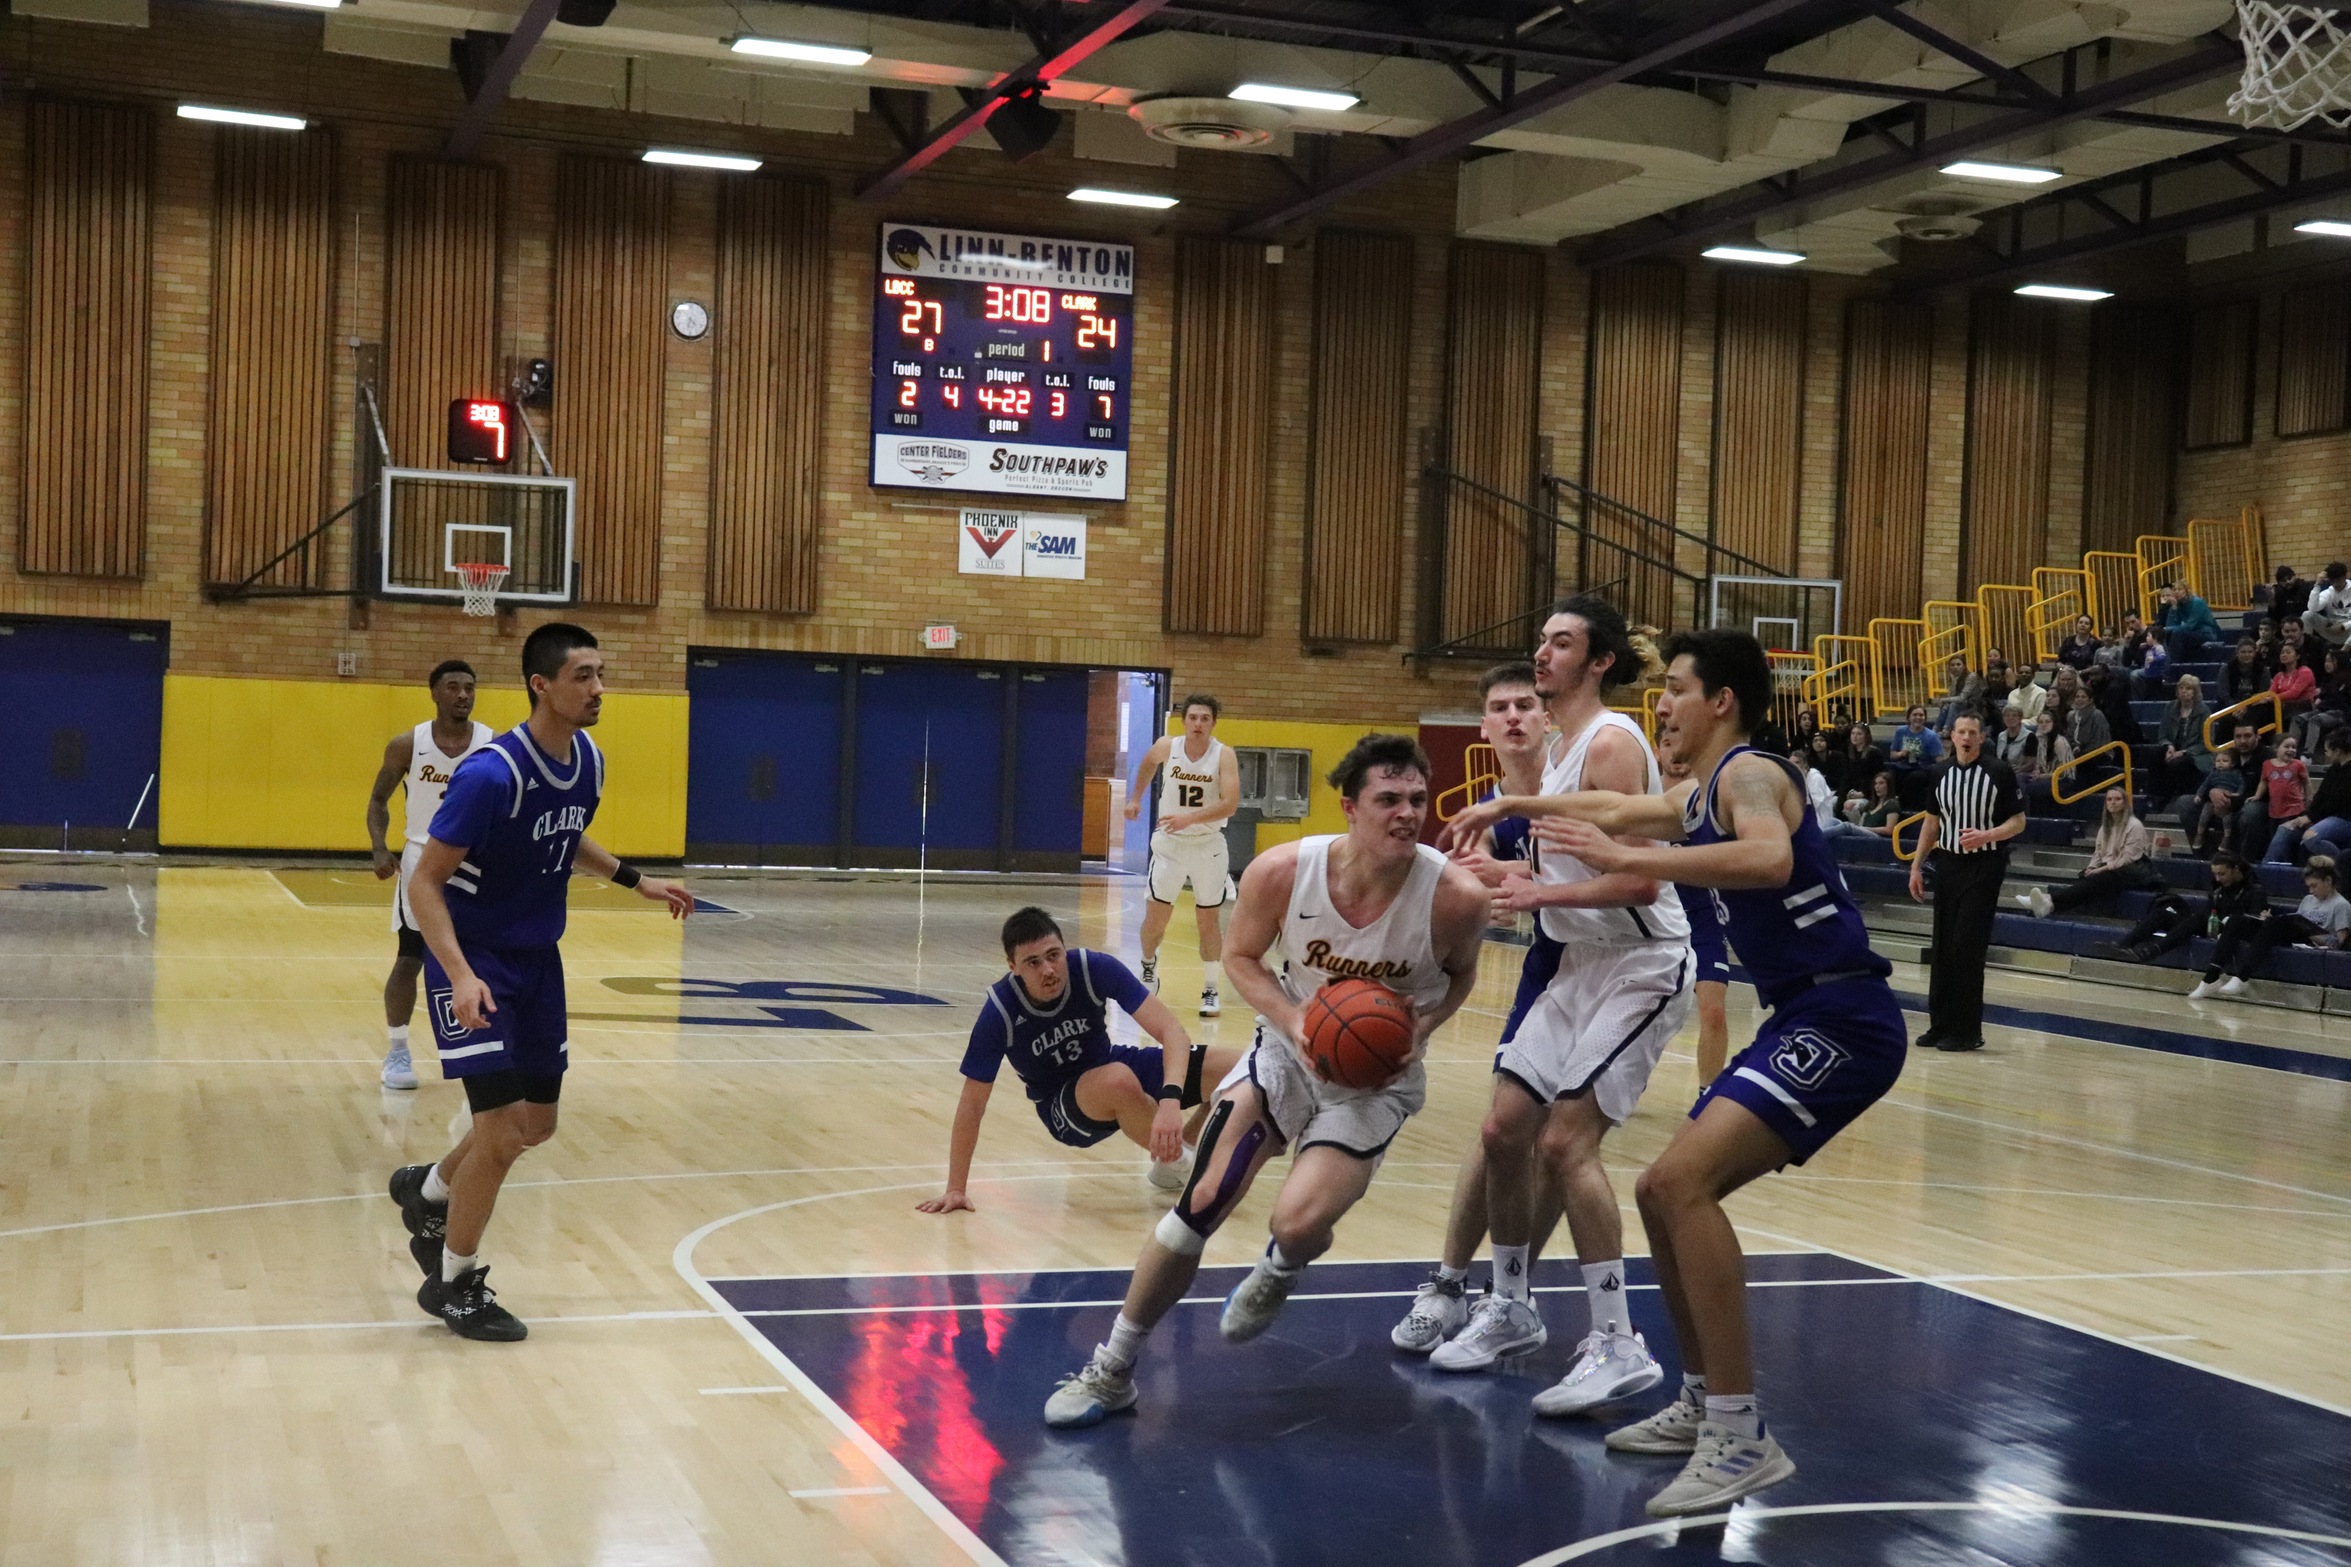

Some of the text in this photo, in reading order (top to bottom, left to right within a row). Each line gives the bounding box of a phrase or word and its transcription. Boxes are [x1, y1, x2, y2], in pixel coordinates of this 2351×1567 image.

[940, 234, 1130, 277] LINN-BENTON
[940, 264, 1130, 289] COMMUNITY COLLEGE
[885, 279, 915, 295] LBCC
[986, 286, 1050, 323] 3:08
[1061, 294, 1097, 311] CLARK
[902, 300, 941, 334] 27
[1078, 315, 1116, 348] 24
[988, 343, 1025, 357] period
[1044, 340, 1050, 361] 1
[893, 360, 921, 376] fouls
[940, 366, 965, 379] t.o.l.
[986, 367, 1025, 384] player
[1045, 374, 1070, 387] t.o.l.
[1088, 376, 1116, 391] fouls
[901, 382, 917, 406] 2
[944, 386, 959, 407] 4
[1051, 392, 1064, 416] 3
[1098, 396, 1111, 419] 7
[894, 413, 917, 425] won
[989, 419, 1019, 433] game
[484, 421, 504, 458] 7
[1089, 427, 1111, 438] won
[900, 446, 929, 457] CENTER
[965, 512, 1018, 528] PHOENIX
[984, 527, 998, 537] INN
[1025, 535, 1076, 555] THE SAM
[975, 560, 1005, 569] SUITES
[931, 627, 950, 642] EXIT
[1170, 766, 1214, 783] Runners
[1178, 785, 1204, 807] 12
[532, 806, 586, 841] CLARK
[1302, 940, 1411, 979] Runners
[1031, 1018, 1091, 1057] CLARK
[1051, 1040, 1083, 1067] 13
